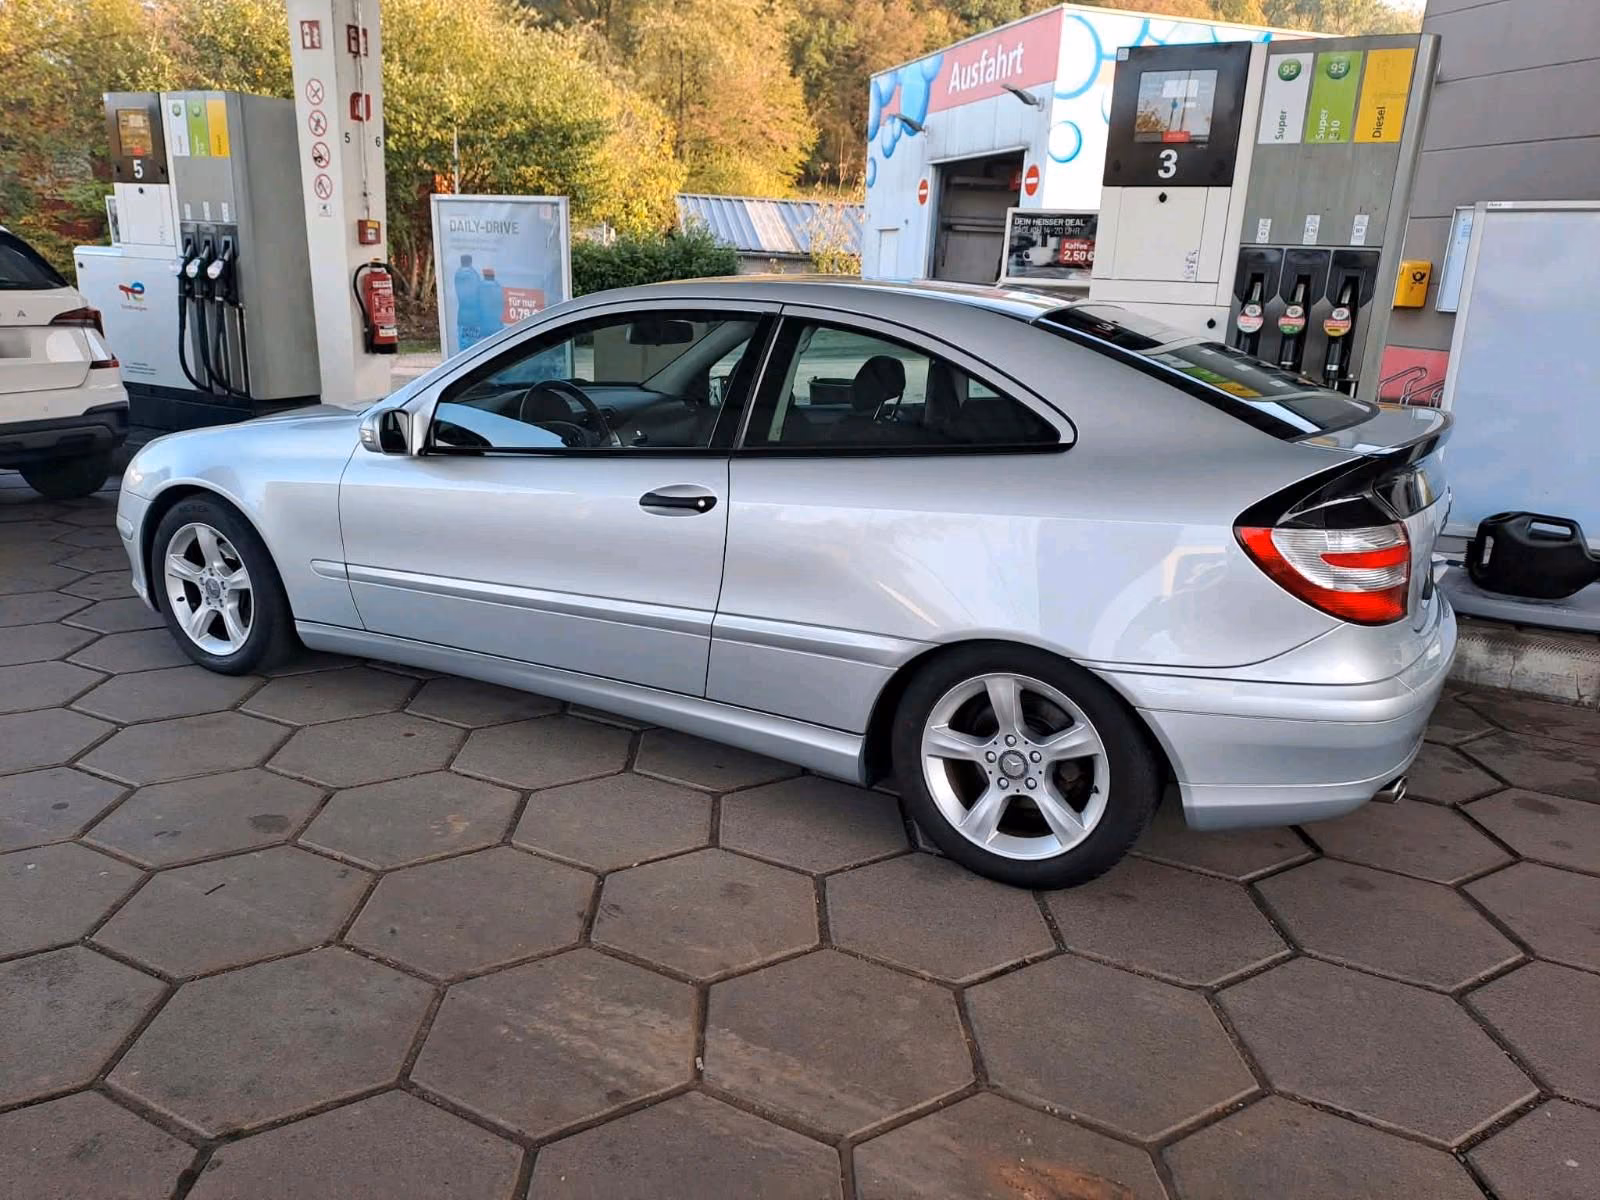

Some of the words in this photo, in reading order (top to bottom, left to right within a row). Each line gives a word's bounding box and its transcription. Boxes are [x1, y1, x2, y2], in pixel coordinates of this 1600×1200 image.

[948, 41, 1024, 95] Ausfahrt
[1282, 64, 1298, 76] 95
[1330, 63, 1345, 74] 95
[1275, 110, 1288, 140] Super
[1315, 108, 1329, 140] Super
[1372, 106, 1386, 138] Diesel
[344, 132, 351, 144] 5
[375, 136, 381, 148] 6
[133, 159, 144, 179] 5
[1157, 149, 1178, 178] 3
[449, 219, 520, 235] DAILY-DRIVE
[1014, 218, 1031, 226] DEIN
[1032, 218, 1063, 226] HEISSER
[1063, 250, 1086, 261] 2,50
[508, 296, 521, 306] für
[522, 299, 537, 308] nur
